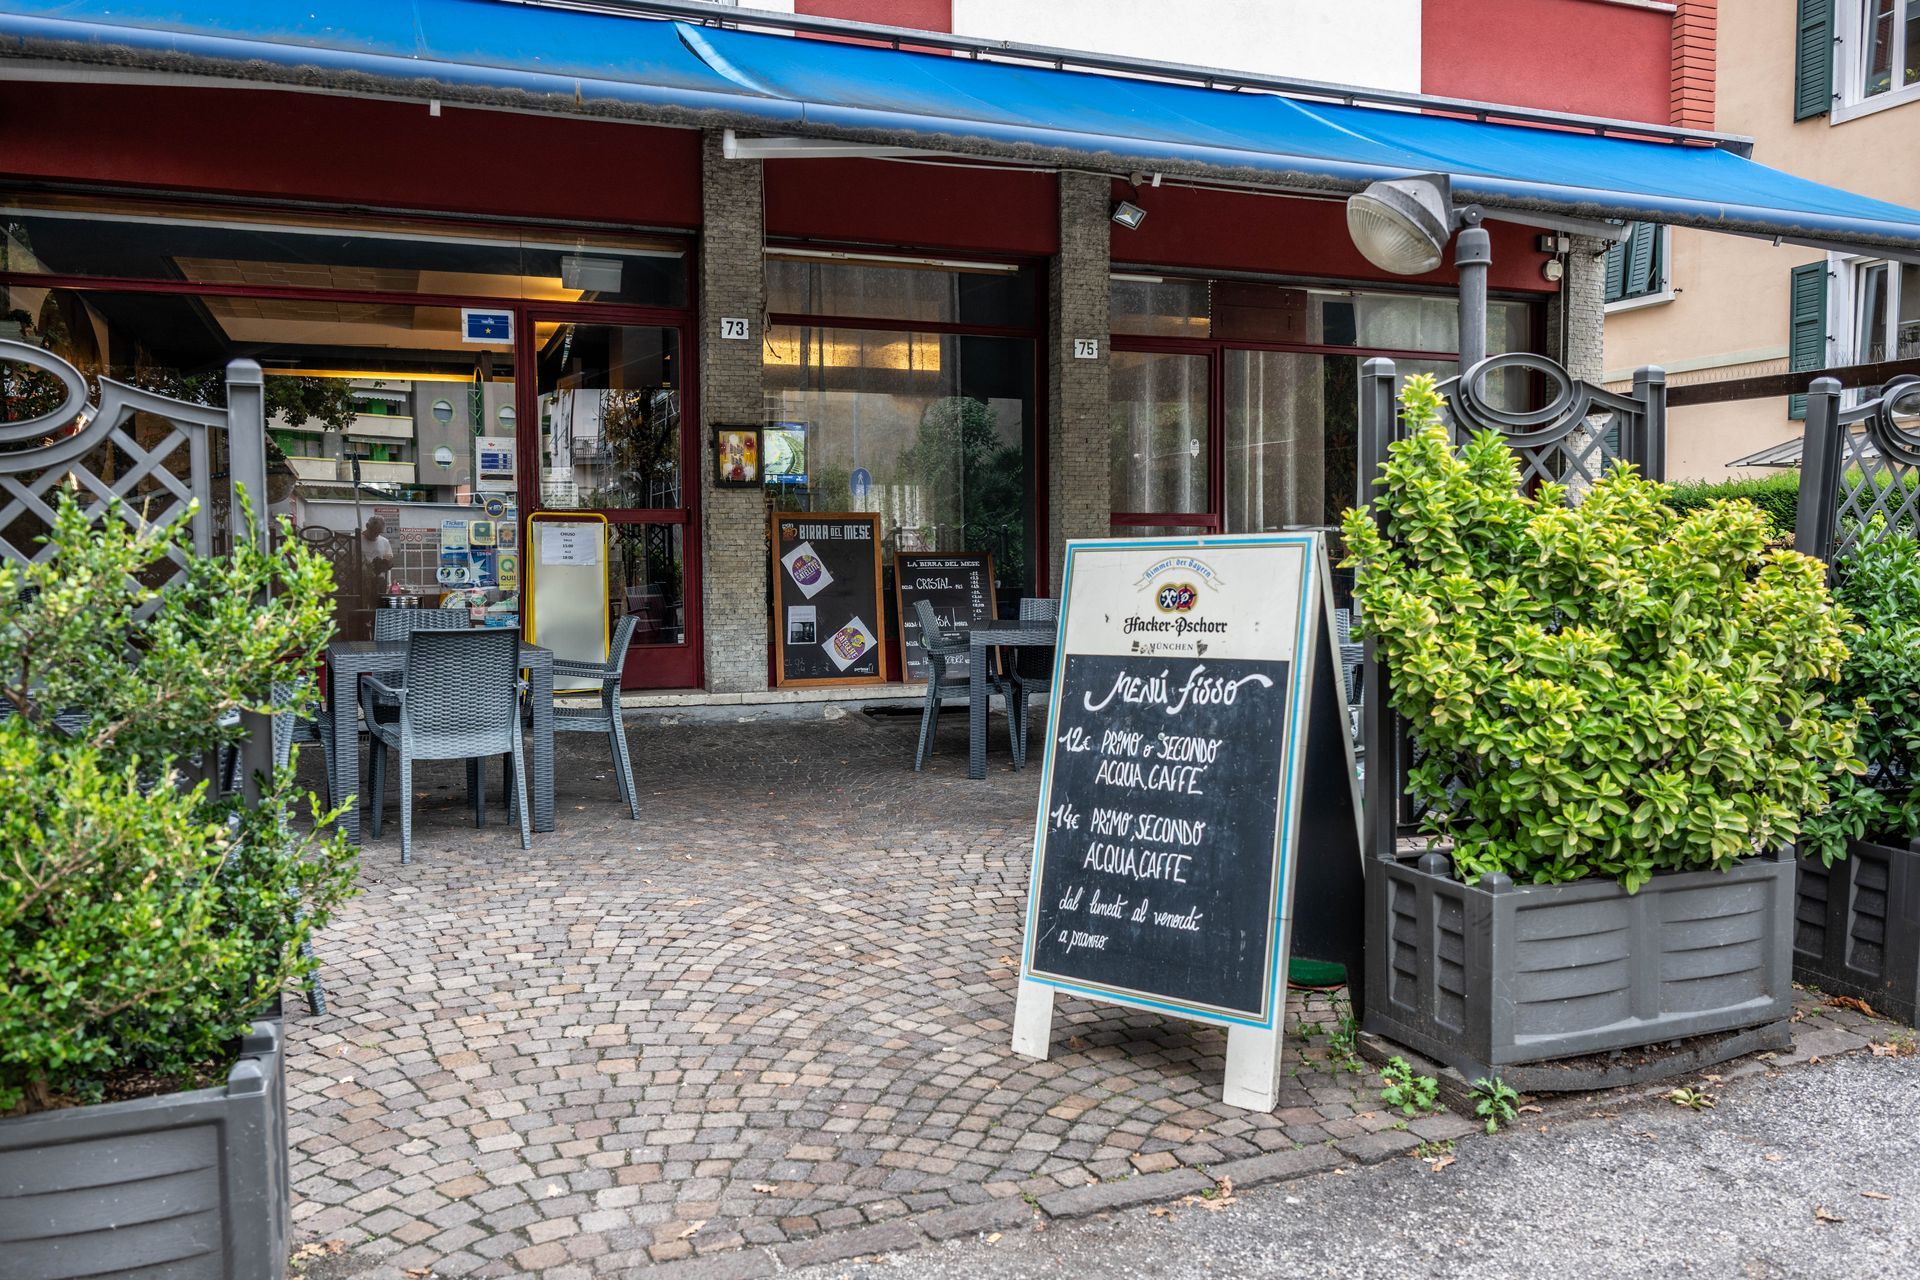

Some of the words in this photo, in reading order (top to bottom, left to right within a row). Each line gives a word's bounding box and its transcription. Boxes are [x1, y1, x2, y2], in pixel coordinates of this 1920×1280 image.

[726, 321, 744, 336] 73
[1079, 342, 1093, 355] 75
[799, 525, 828, 539] BIRRA
[831, 528, 842, 536] DEL
[844, 525, 871, 539] MESE
[1146, 560, 1172, 579] Himmel
[1188, 560, 1211, 578] Bayern
[916, 578, 952, 589] CRISTAL
[1124, 616, 1228, 637] Hacker-Pschorr
[836, 632, 859, 660] SATELLITE
[1150, 642, 1194, 651] MÜNCHEN
[1084, 669, 1169, 711] MENÚ
[1166, 664, 1273, 715] fisso
[1058, 727, 1091, 752] 12€
[1101, 730, 1143, 756] PRIMO
[1157, 734, 1222, 763] SECONDO
[1051, 803, 1080, 829] 14€
[1135, 814, 1206, 846] SECONDO
[1059, 886, 1083, 911] dal
[1131, 899, 1149, 922] al
[1058, 930, 1068, 943] a
